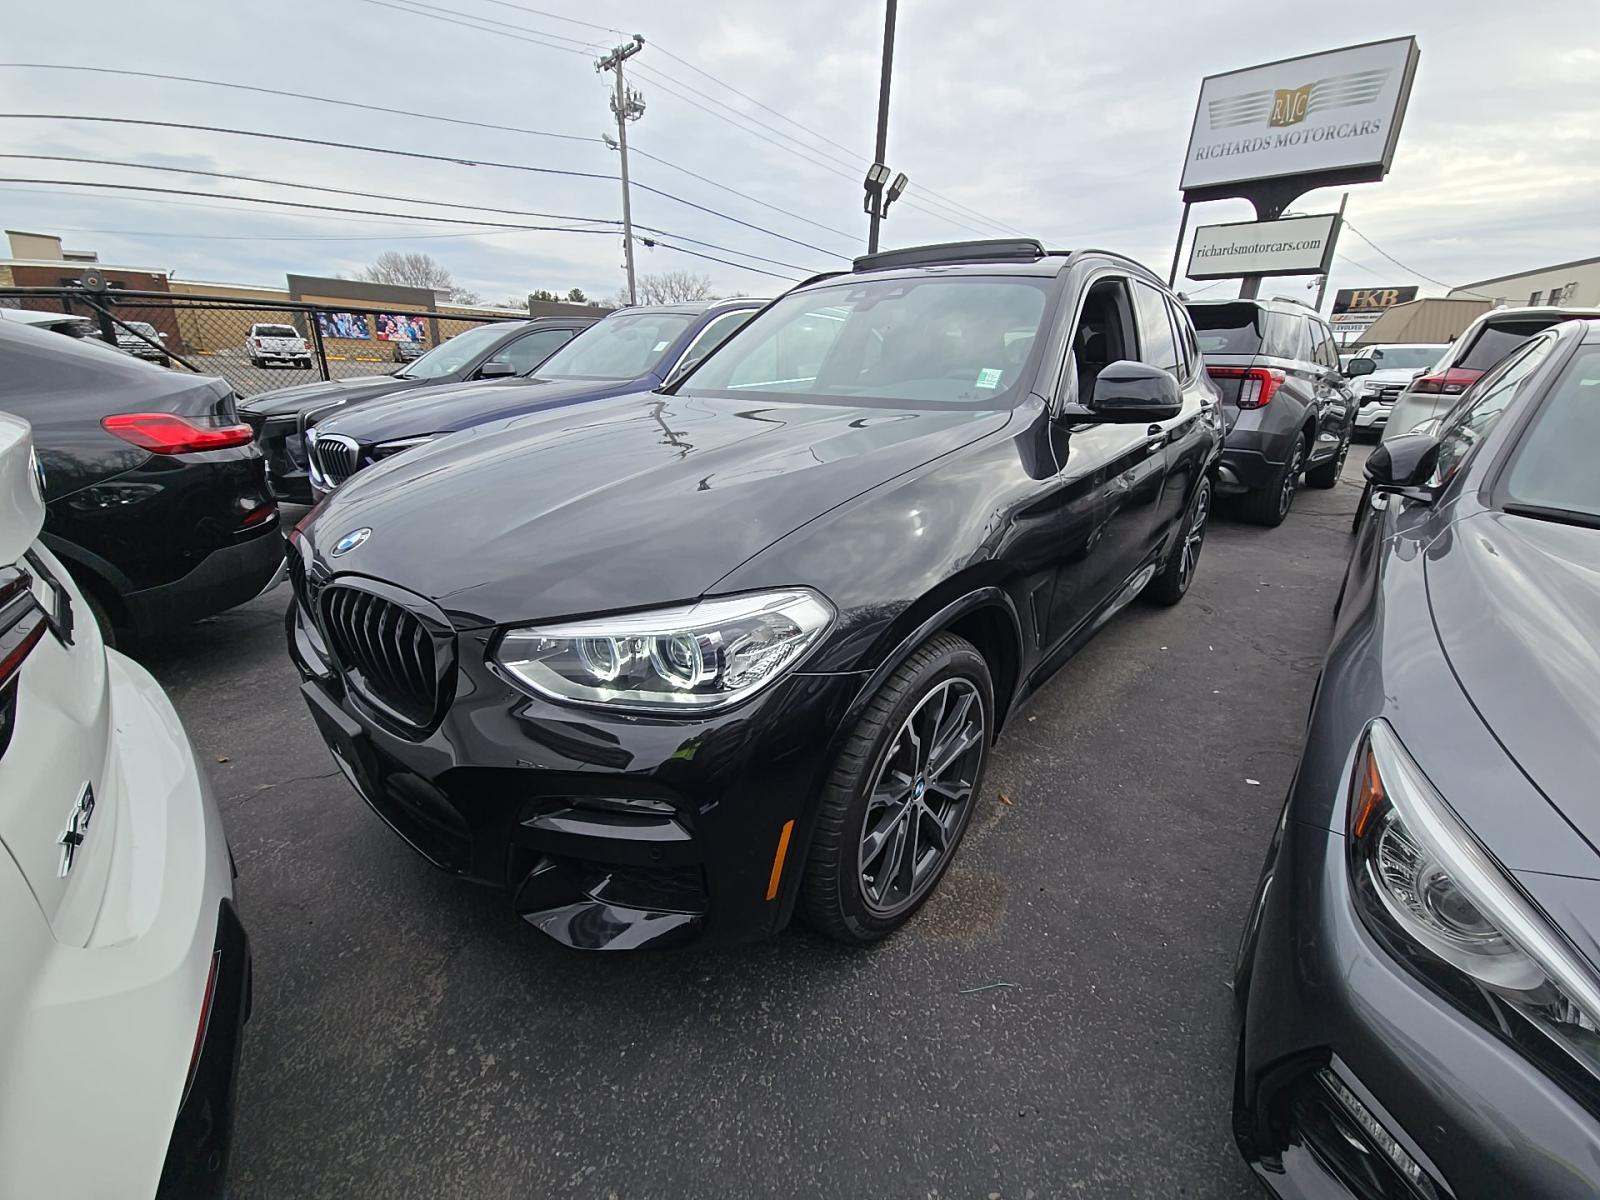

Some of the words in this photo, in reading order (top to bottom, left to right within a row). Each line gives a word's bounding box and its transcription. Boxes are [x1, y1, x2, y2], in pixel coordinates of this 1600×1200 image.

[1272, 94, 1308, 124] RMC
[1196, 135, 1272, 161] RICHARDS
[1274, 119, 1382, 149] MOTORCARS
[1196, 239, 1321, 258] richardsmotorcars.com
